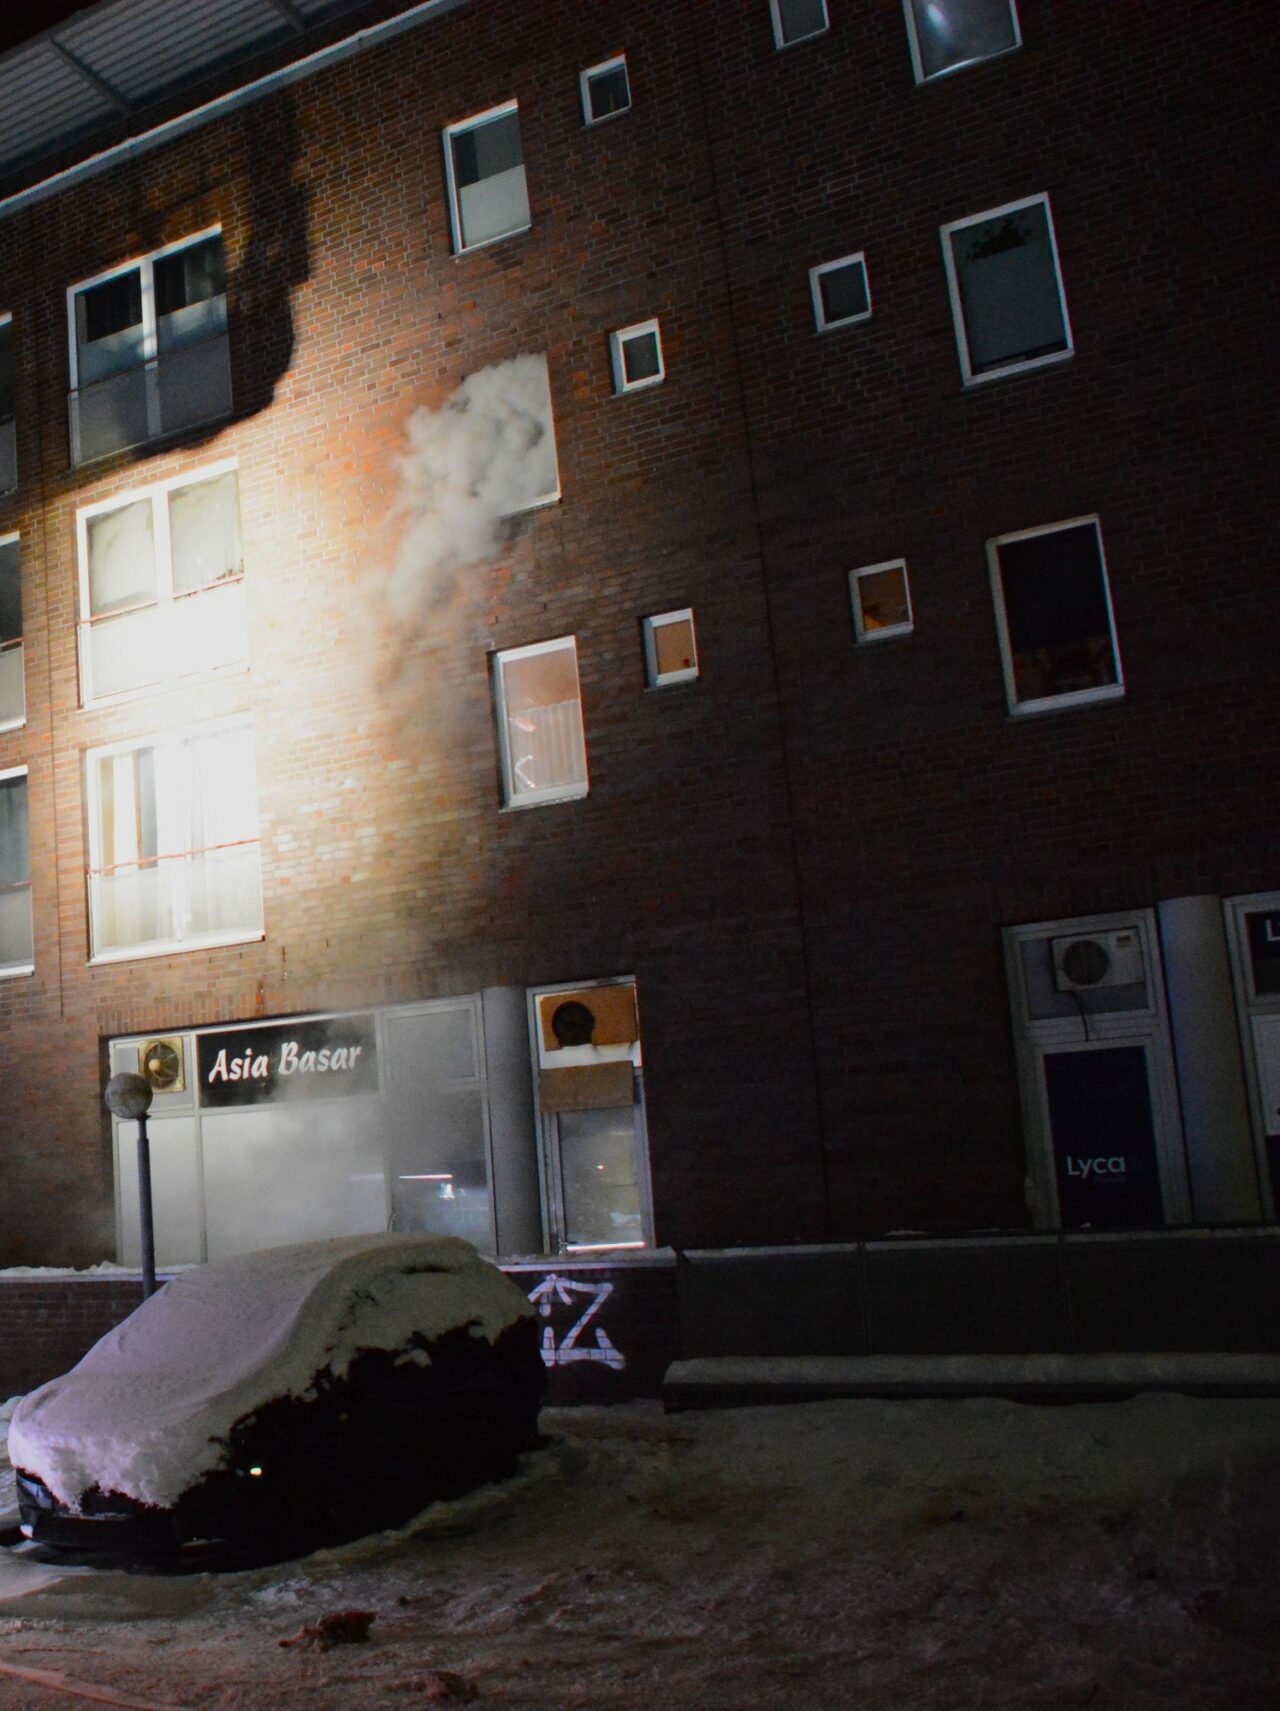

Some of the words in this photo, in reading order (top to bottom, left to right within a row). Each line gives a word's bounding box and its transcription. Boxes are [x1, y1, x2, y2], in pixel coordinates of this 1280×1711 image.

[208, 1048, 269, 1083] Asia
[278, 1041, 362, 1075] Basar
[1066, 1155, 1126, 1179] Lyca
